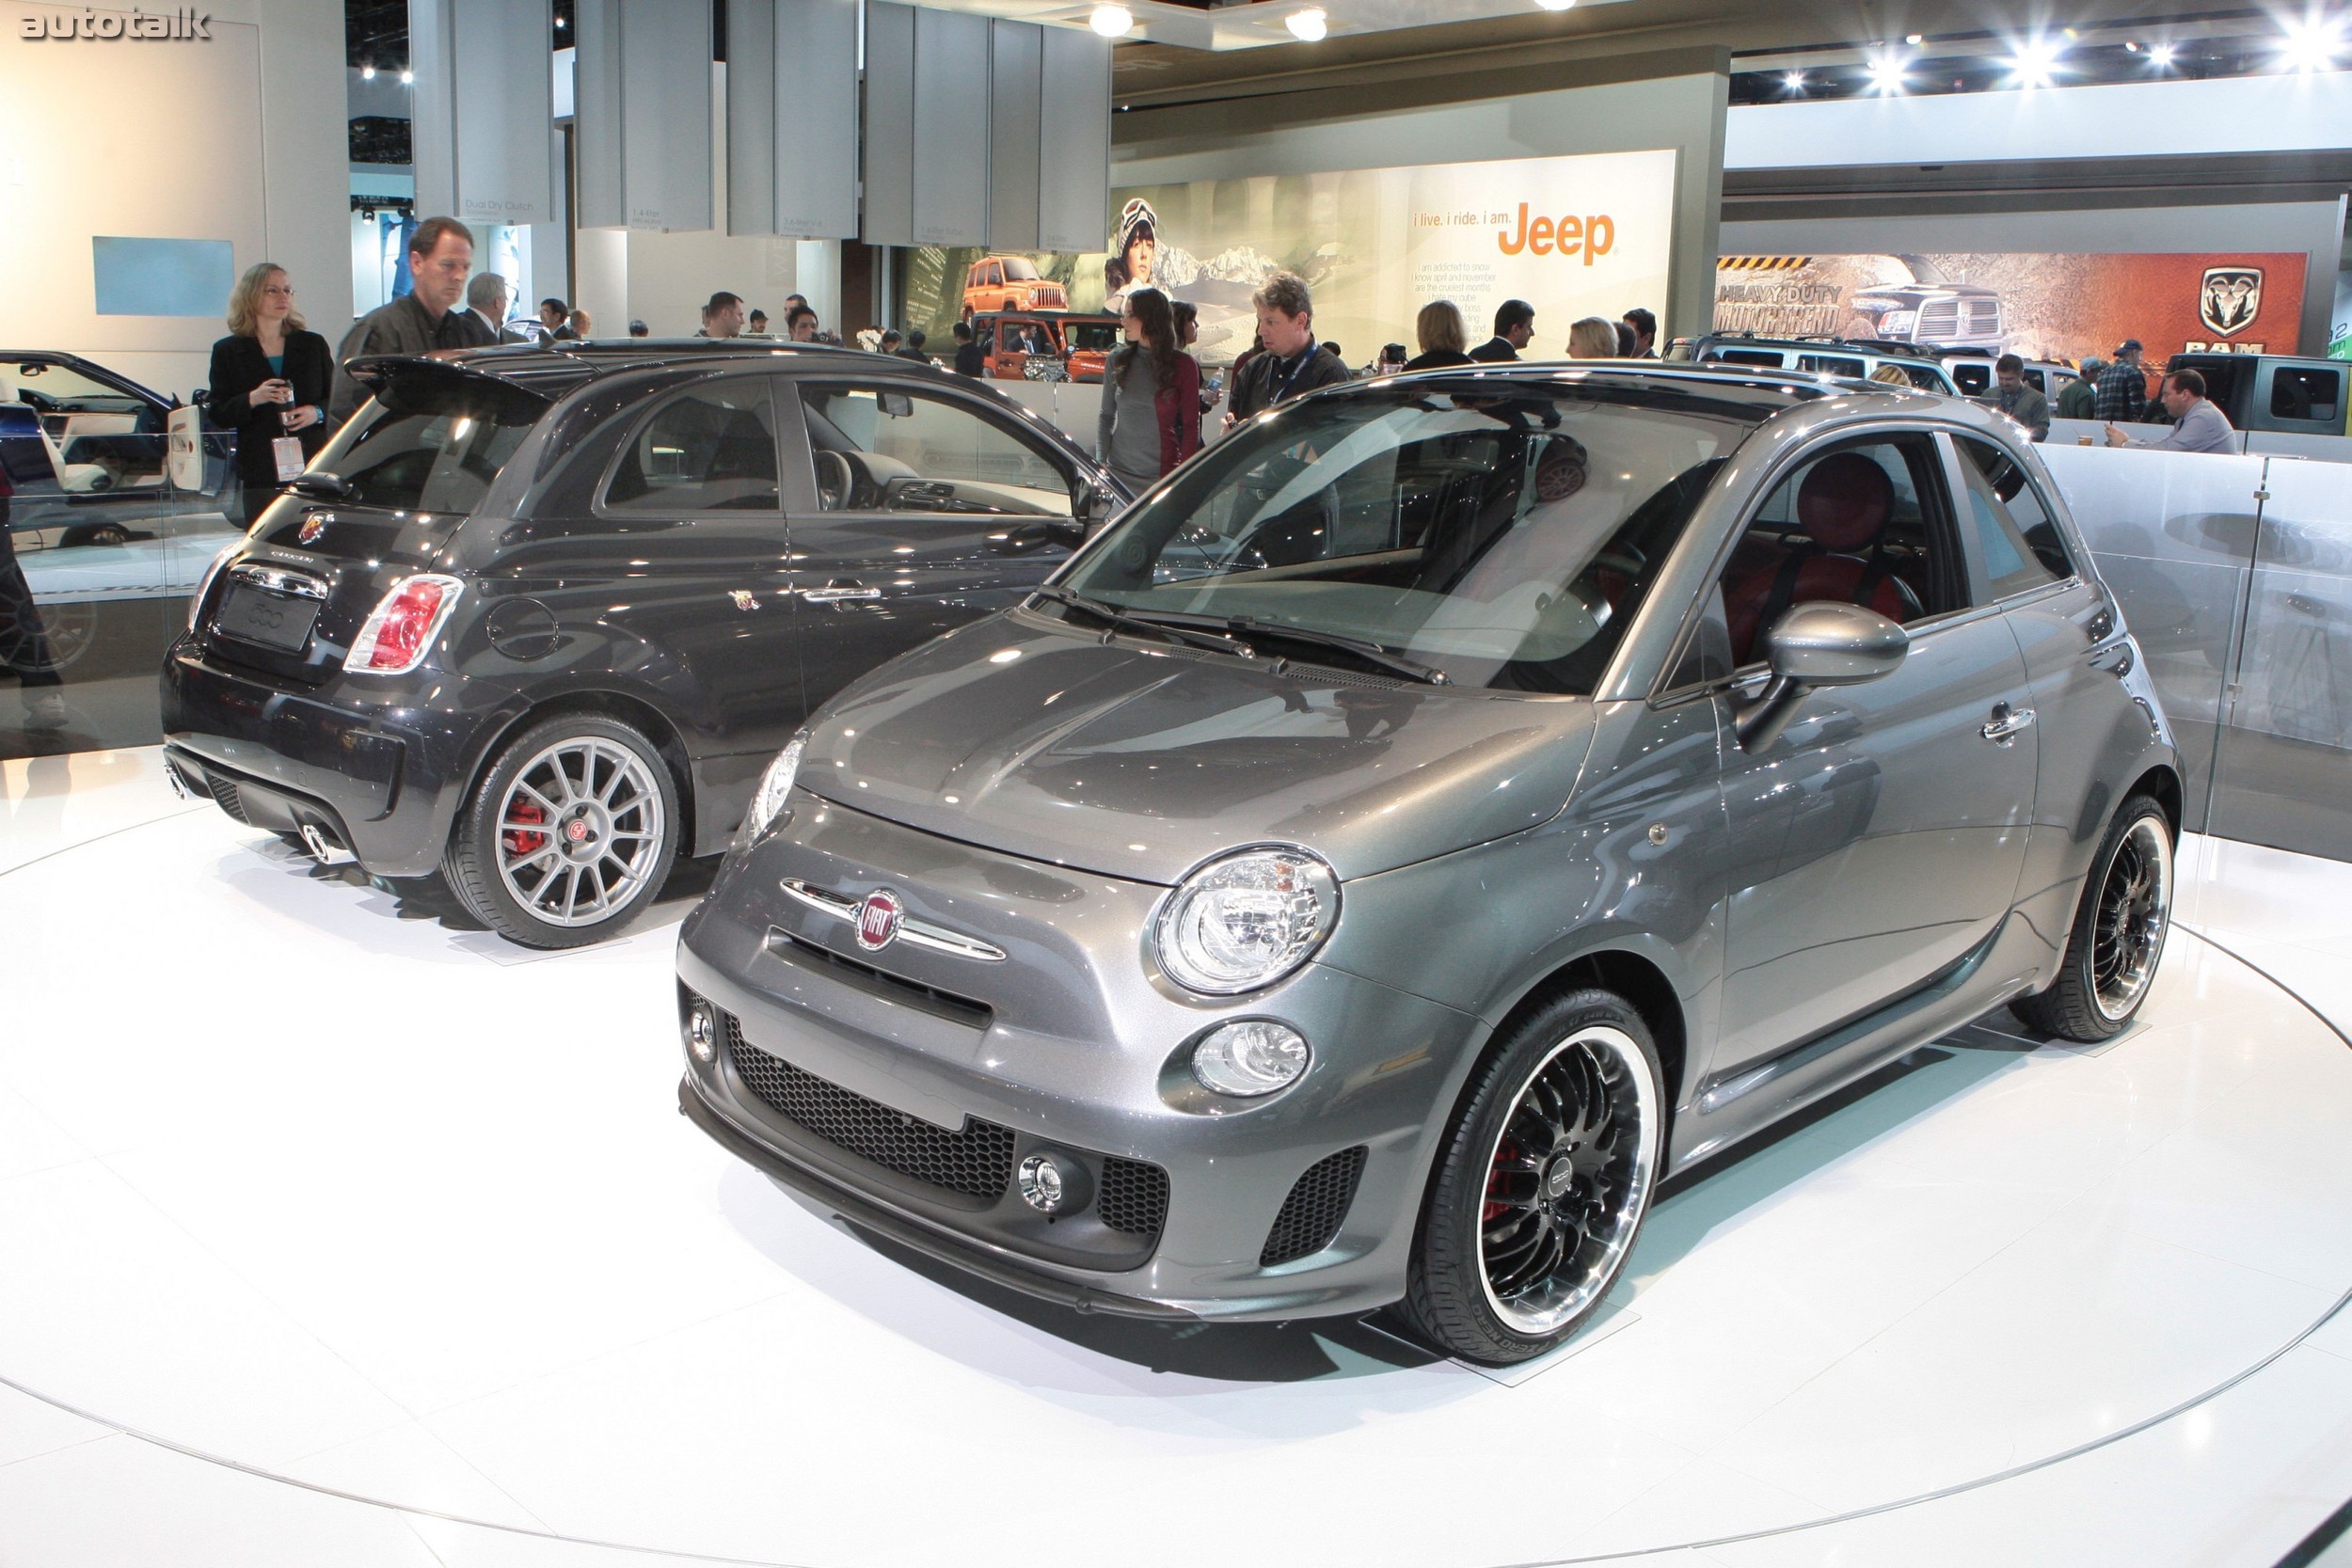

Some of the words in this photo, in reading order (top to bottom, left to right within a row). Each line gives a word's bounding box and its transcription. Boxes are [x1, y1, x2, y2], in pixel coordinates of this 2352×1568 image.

[1420, 213, 1443, 227] live.
[1454, 211, 1480, 226] ride.
[1489, 213, 1512, 225] am.
[1498, 202, 1615, 266] Jeep
[1433, 262, 1462, 272] addicted
[1464, 263, 1470, 272] to
[1471, 263, 1490, 272] snow
[1414, 273, 1432, 281] know
[1434, 273, 1448, 283] april
[1449, 273, 1462, 281] and
[1463, 273, 1497, 281] november
[1426, 283, 1438, 292] the
[1438, 283, 1464, 292] cruelest
[1466, 284, 1491, 293] months
[1459, 293, 1477, 302] cube
[1719, 285, 1783, 303] HEAVY
[1786, 285, 1843, 304] DUTY
[1464, 303, 1482, 312] boss
[863, 904, 892, 937] FIAT
